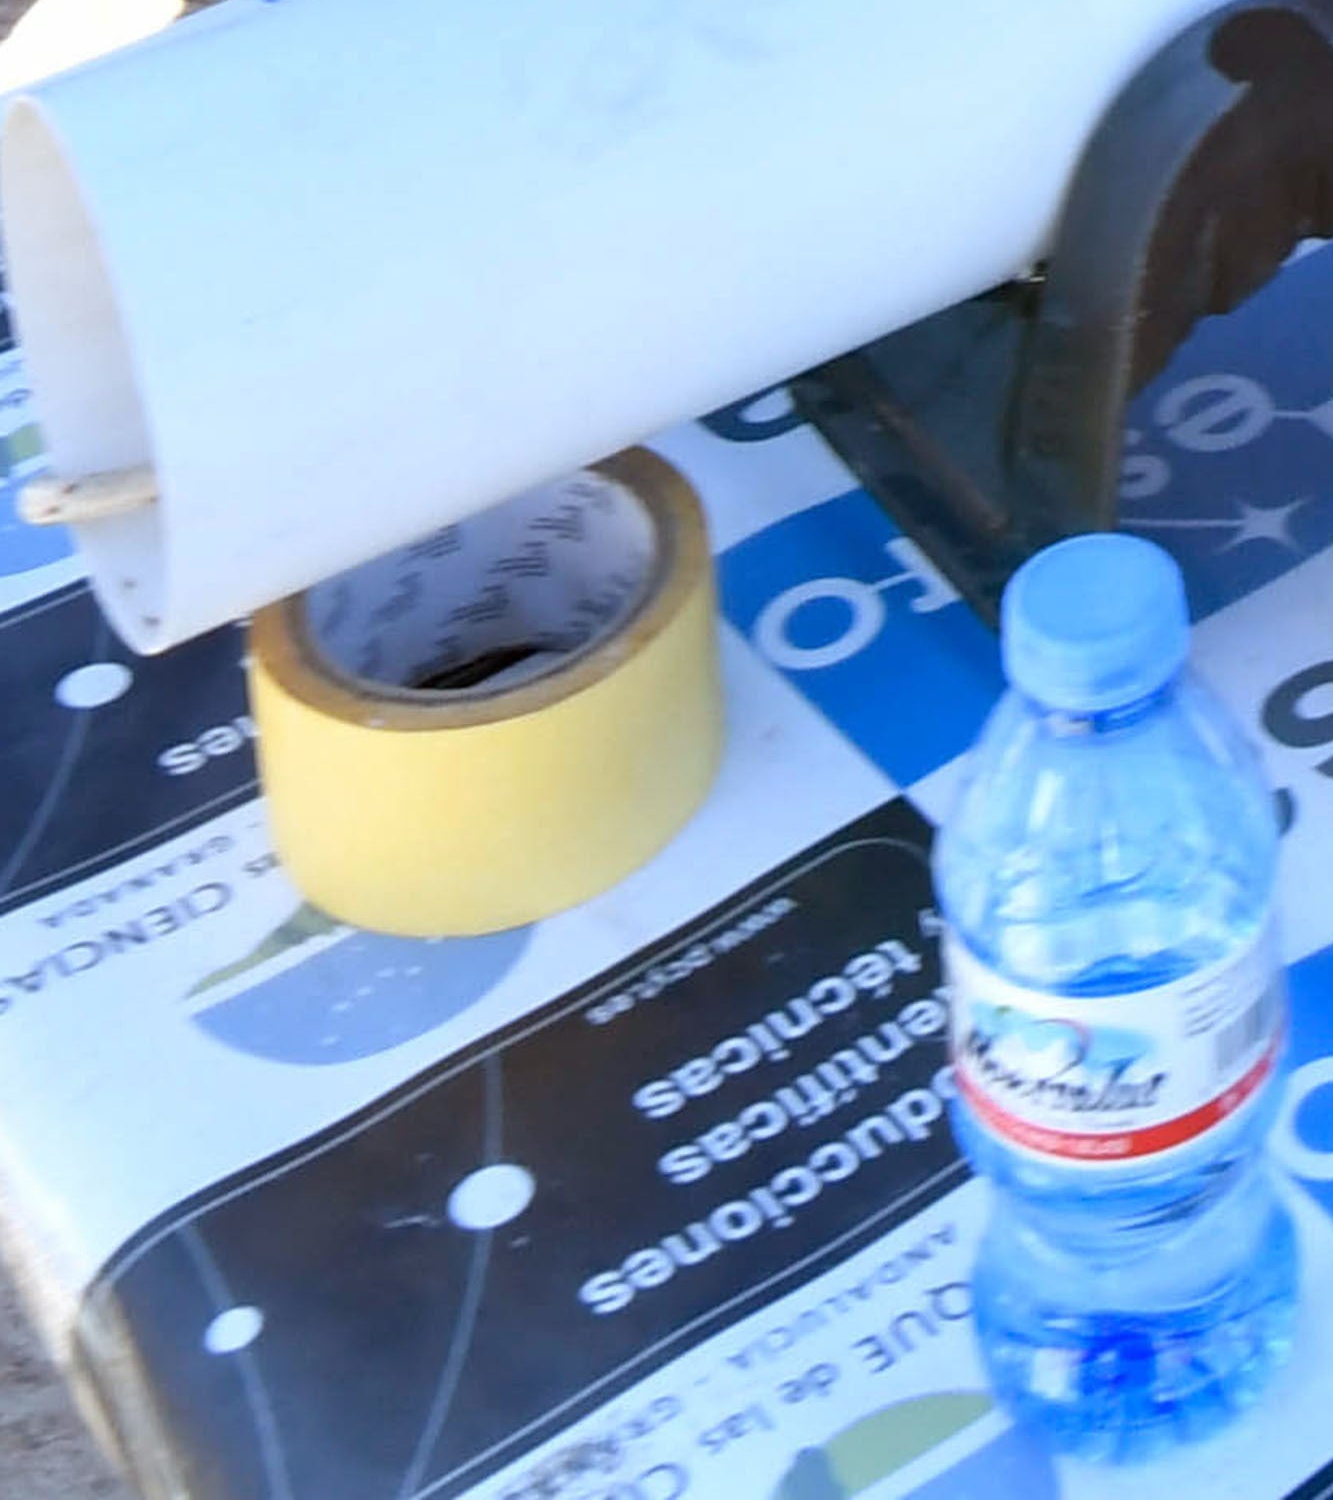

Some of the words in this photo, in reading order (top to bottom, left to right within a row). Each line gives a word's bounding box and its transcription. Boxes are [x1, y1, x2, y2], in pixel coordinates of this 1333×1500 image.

[631, 939, 922, 1119] técnicas
[656, 985, 953, 1185] entíficas
[577, 1062, 957, 1315] oducciones
[776, 1361, 841, 1405] de
[850, 1280, 973, 1375] QUE
[698, 1402, 777, 1455] las
